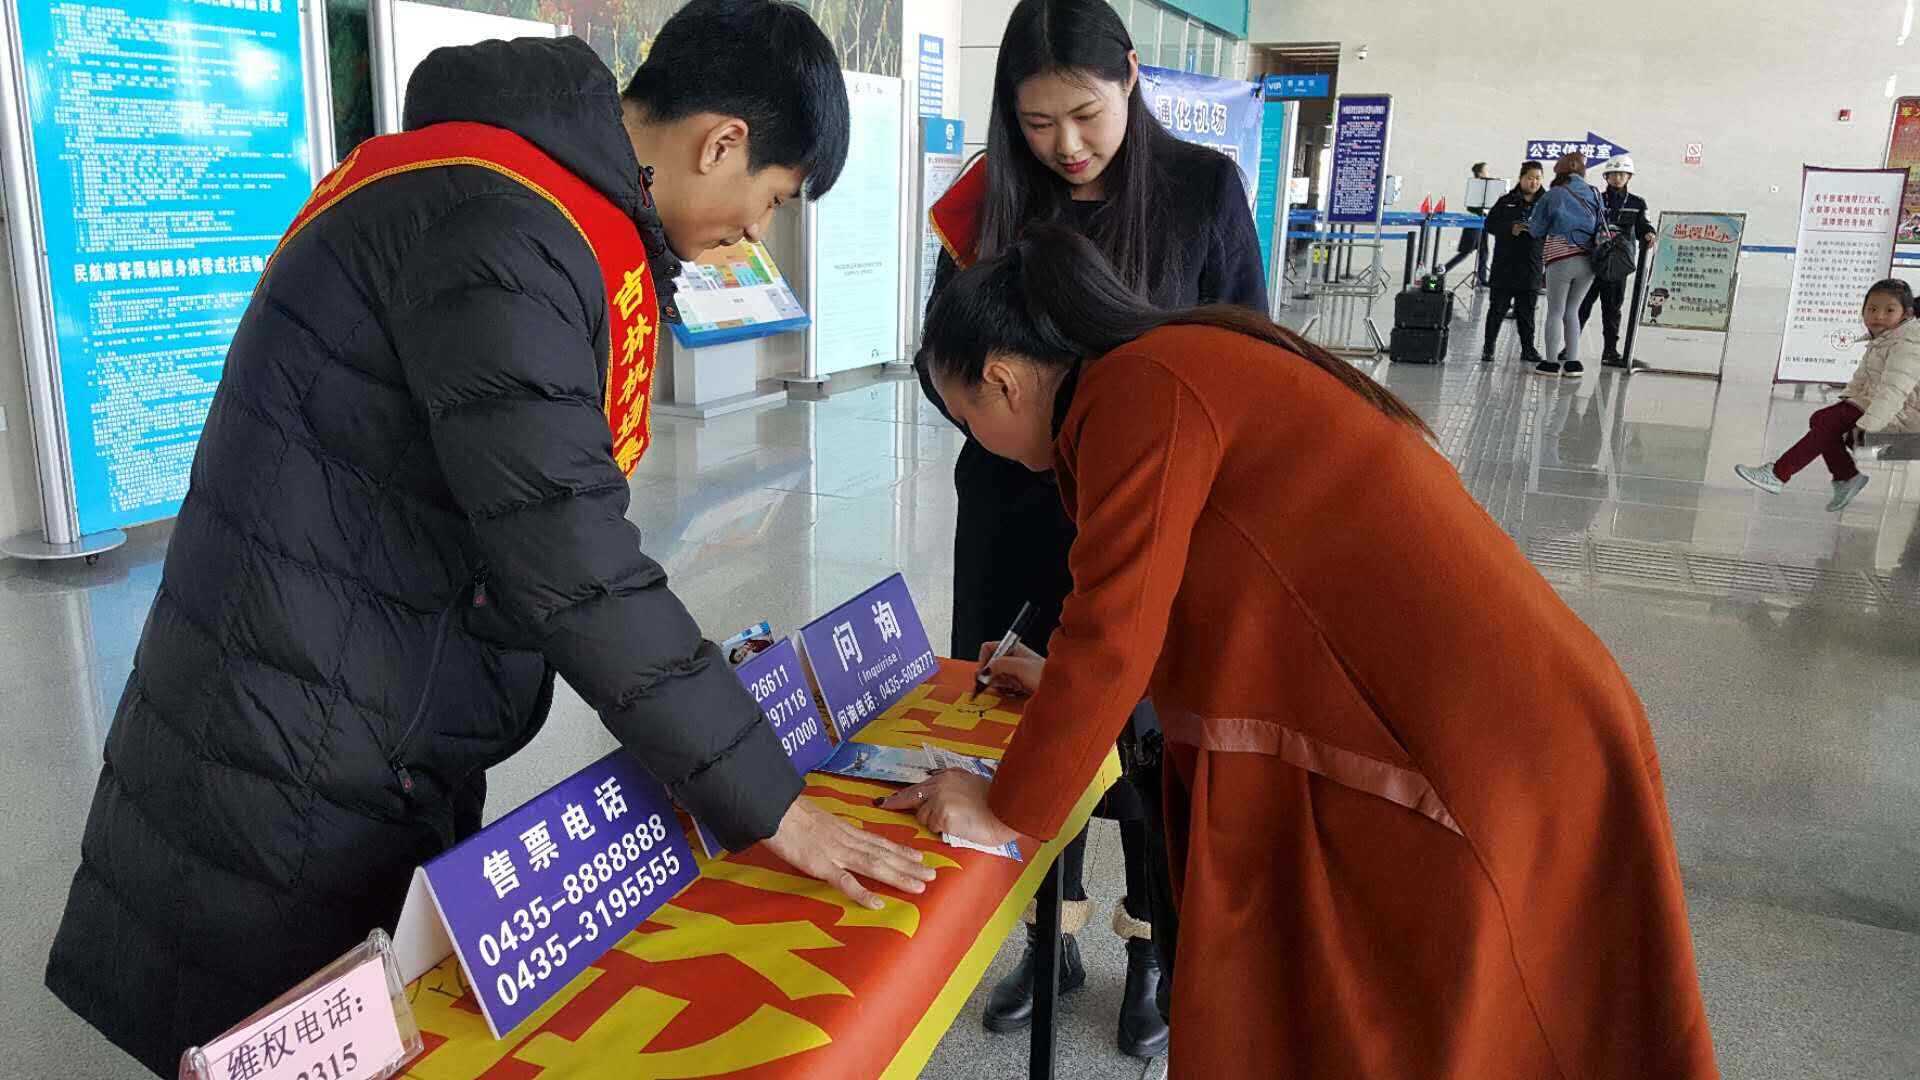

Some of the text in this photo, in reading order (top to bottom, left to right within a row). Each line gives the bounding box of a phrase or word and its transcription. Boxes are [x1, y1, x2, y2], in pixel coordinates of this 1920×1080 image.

[1155, 96, 1228, 136] 通化机场
[747, 663, 790, 703] 26611
[832, 600, 902, 672] 问询
[483, 776, 627, 899] 售票电话
[478, 813, 666, 966] 0435-8888888
[497, 846, 680, 1006] 0435-3195555
